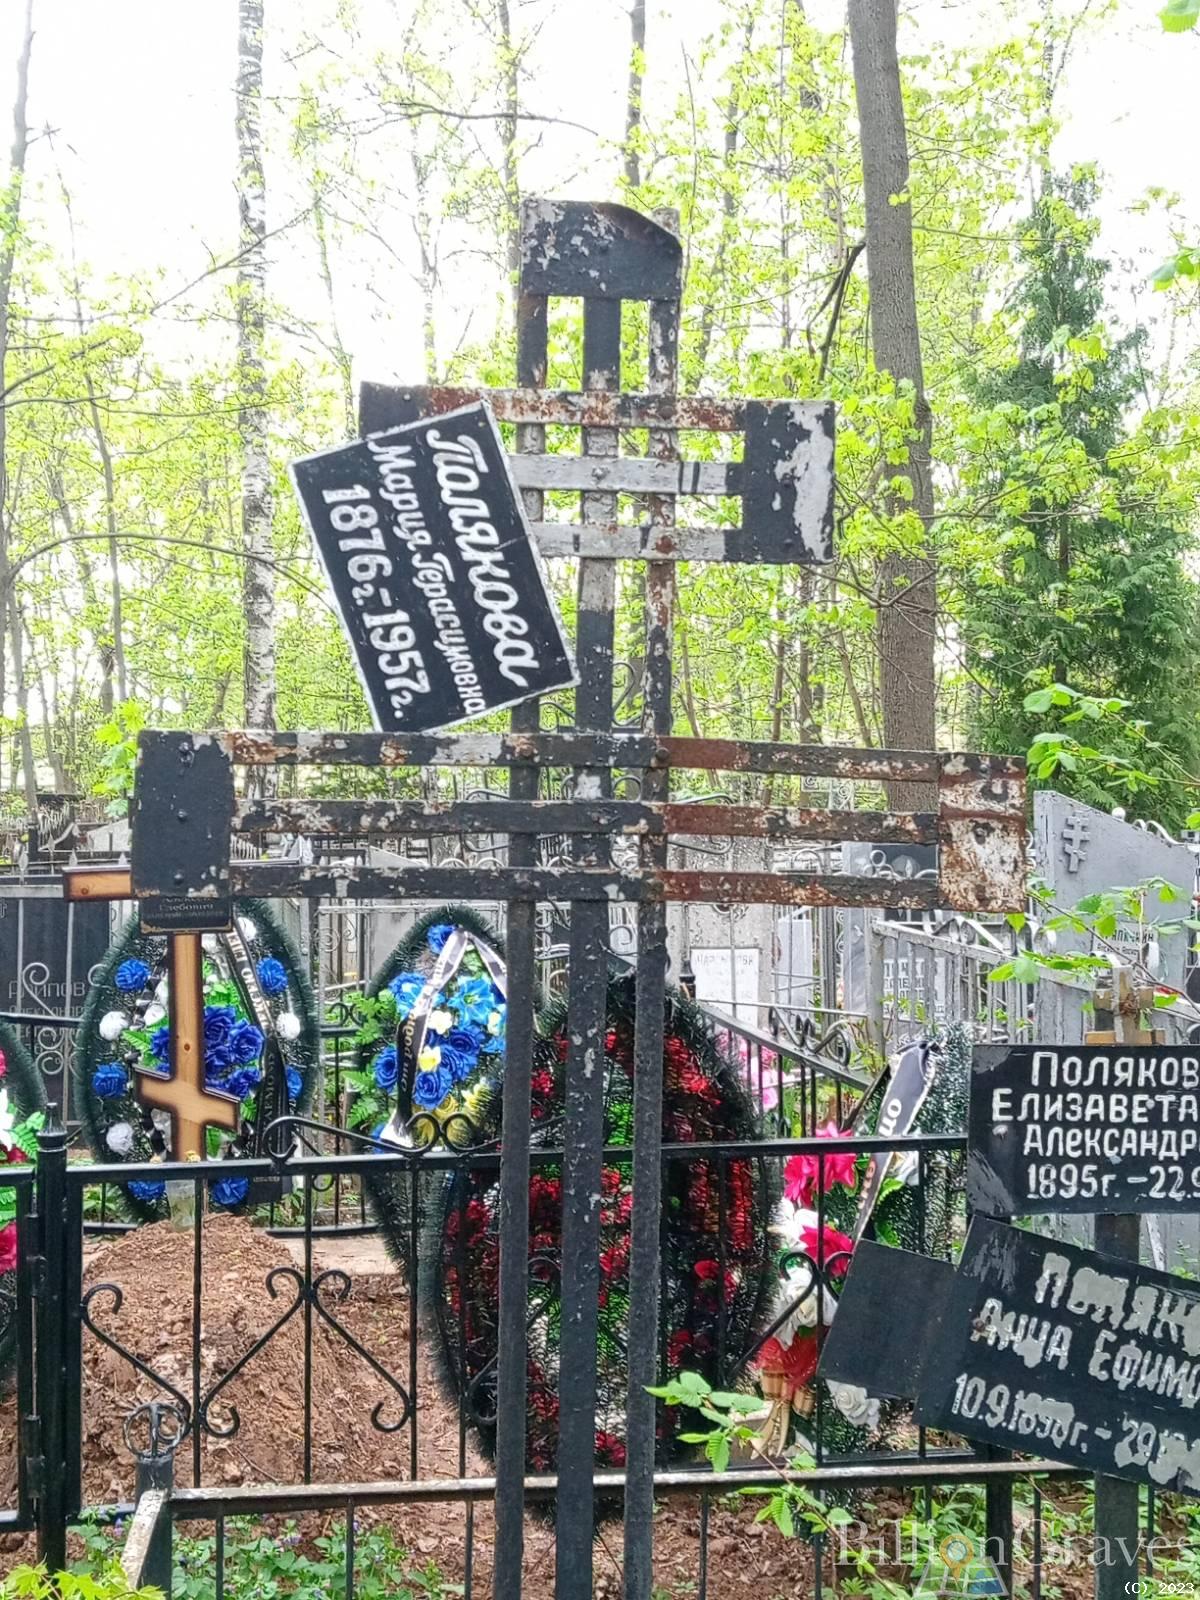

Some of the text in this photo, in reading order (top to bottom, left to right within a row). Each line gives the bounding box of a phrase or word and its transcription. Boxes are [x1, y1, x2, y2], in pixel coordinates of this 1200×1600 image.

[367, 437, 487, 715] Мария Герасимовна
[425, 428, 540, 688] Полякова
